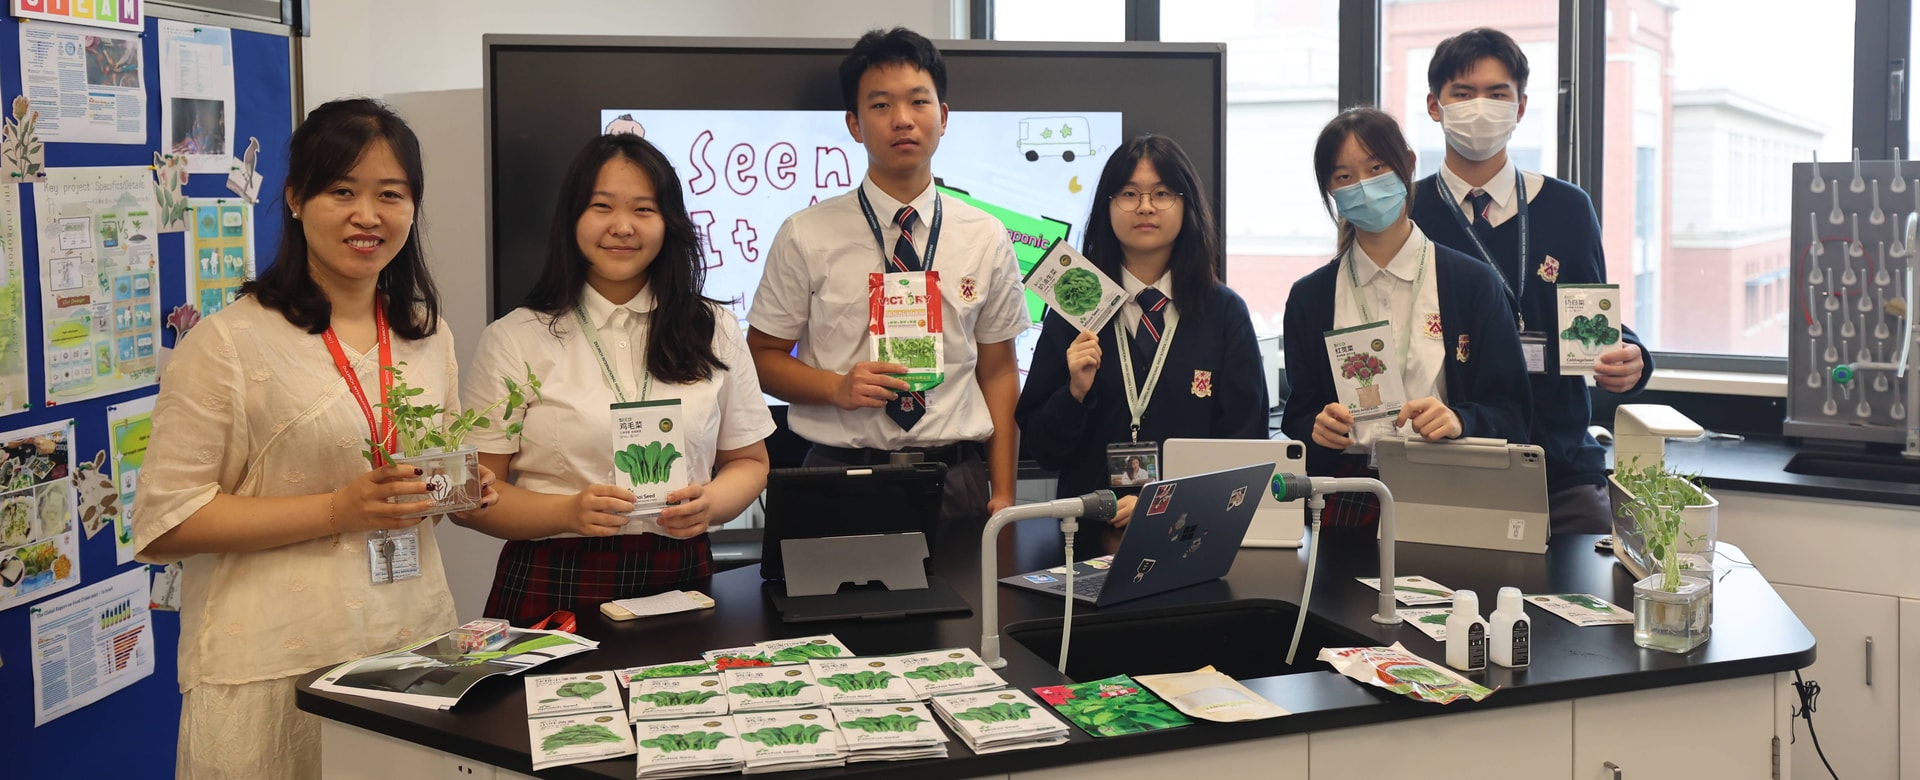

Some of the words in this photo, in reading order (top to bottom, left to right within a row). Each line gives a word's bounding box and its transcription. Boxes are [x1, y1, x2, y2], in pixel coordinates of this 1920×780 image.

[689, 130, 852, 195] Seen
[44, 183, 58, 195] Key
[63, 182, 91, 195] project
[691, 210, 759, 270] It
[619, 421, 643, 430] 鸡毛菜
